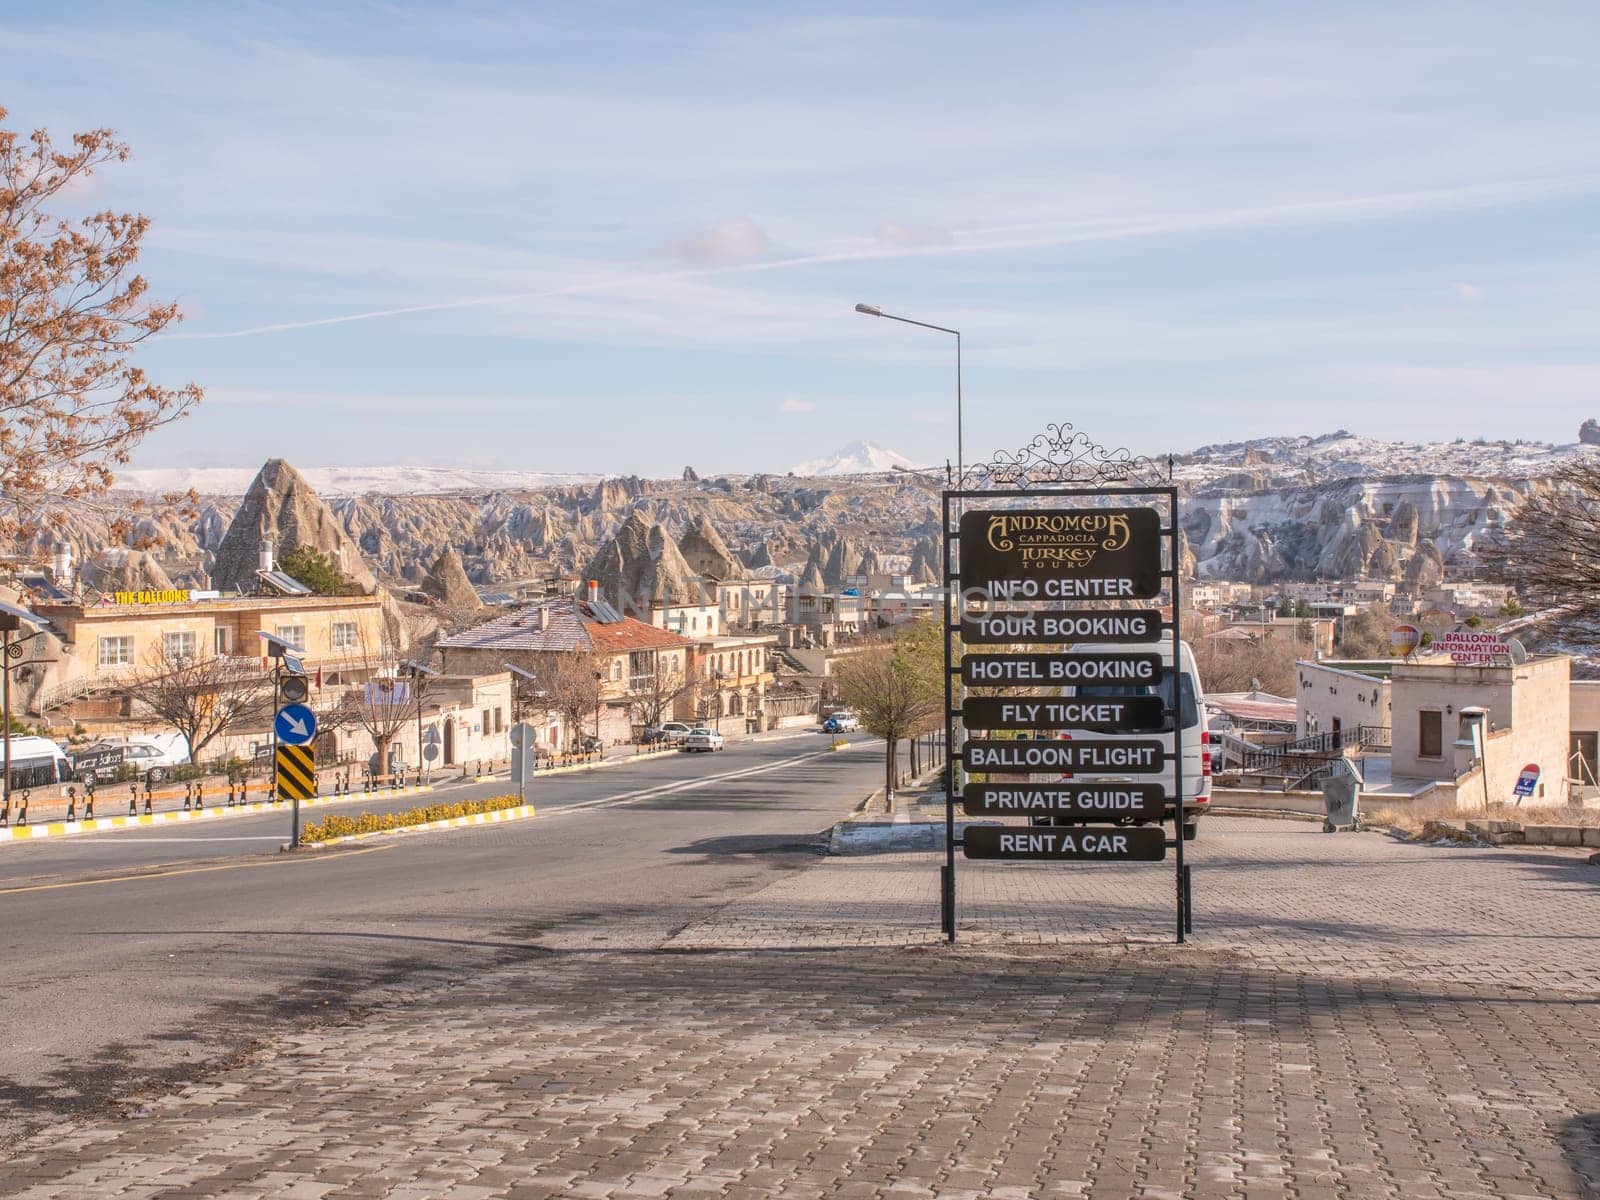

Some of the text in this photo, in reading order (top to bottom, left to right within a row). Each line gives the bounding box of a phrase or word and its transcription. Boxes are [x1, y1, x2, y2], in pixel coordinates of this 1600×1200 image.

[987, 514, 1130, 551] ANDROMEDA
[1019, 534, 1096, 543] CAPPADOCIA
[138, 589, 189, 604] BALLOONS
[987, 578, 1134, 598] INFO CENTER
[978, 617, 1147, 636] TOUR BOOKING
[1446, 634, 1497, 643] BALLOON
[1433, 643, 1510, 653] INFORMATION
[1450, 652, 1492, 662] CENTER
[971, 660, 1153, 679] HOTEL BOOKING
[1002, 704, 1124, 722] FLY TICKET
[971, 748, 1155, 766] BALLOON FLIGHT
[984, 791, 1144, 809] PRIVATE GUIDE
[1000, 834, 1128, 853] RENT A CAR
